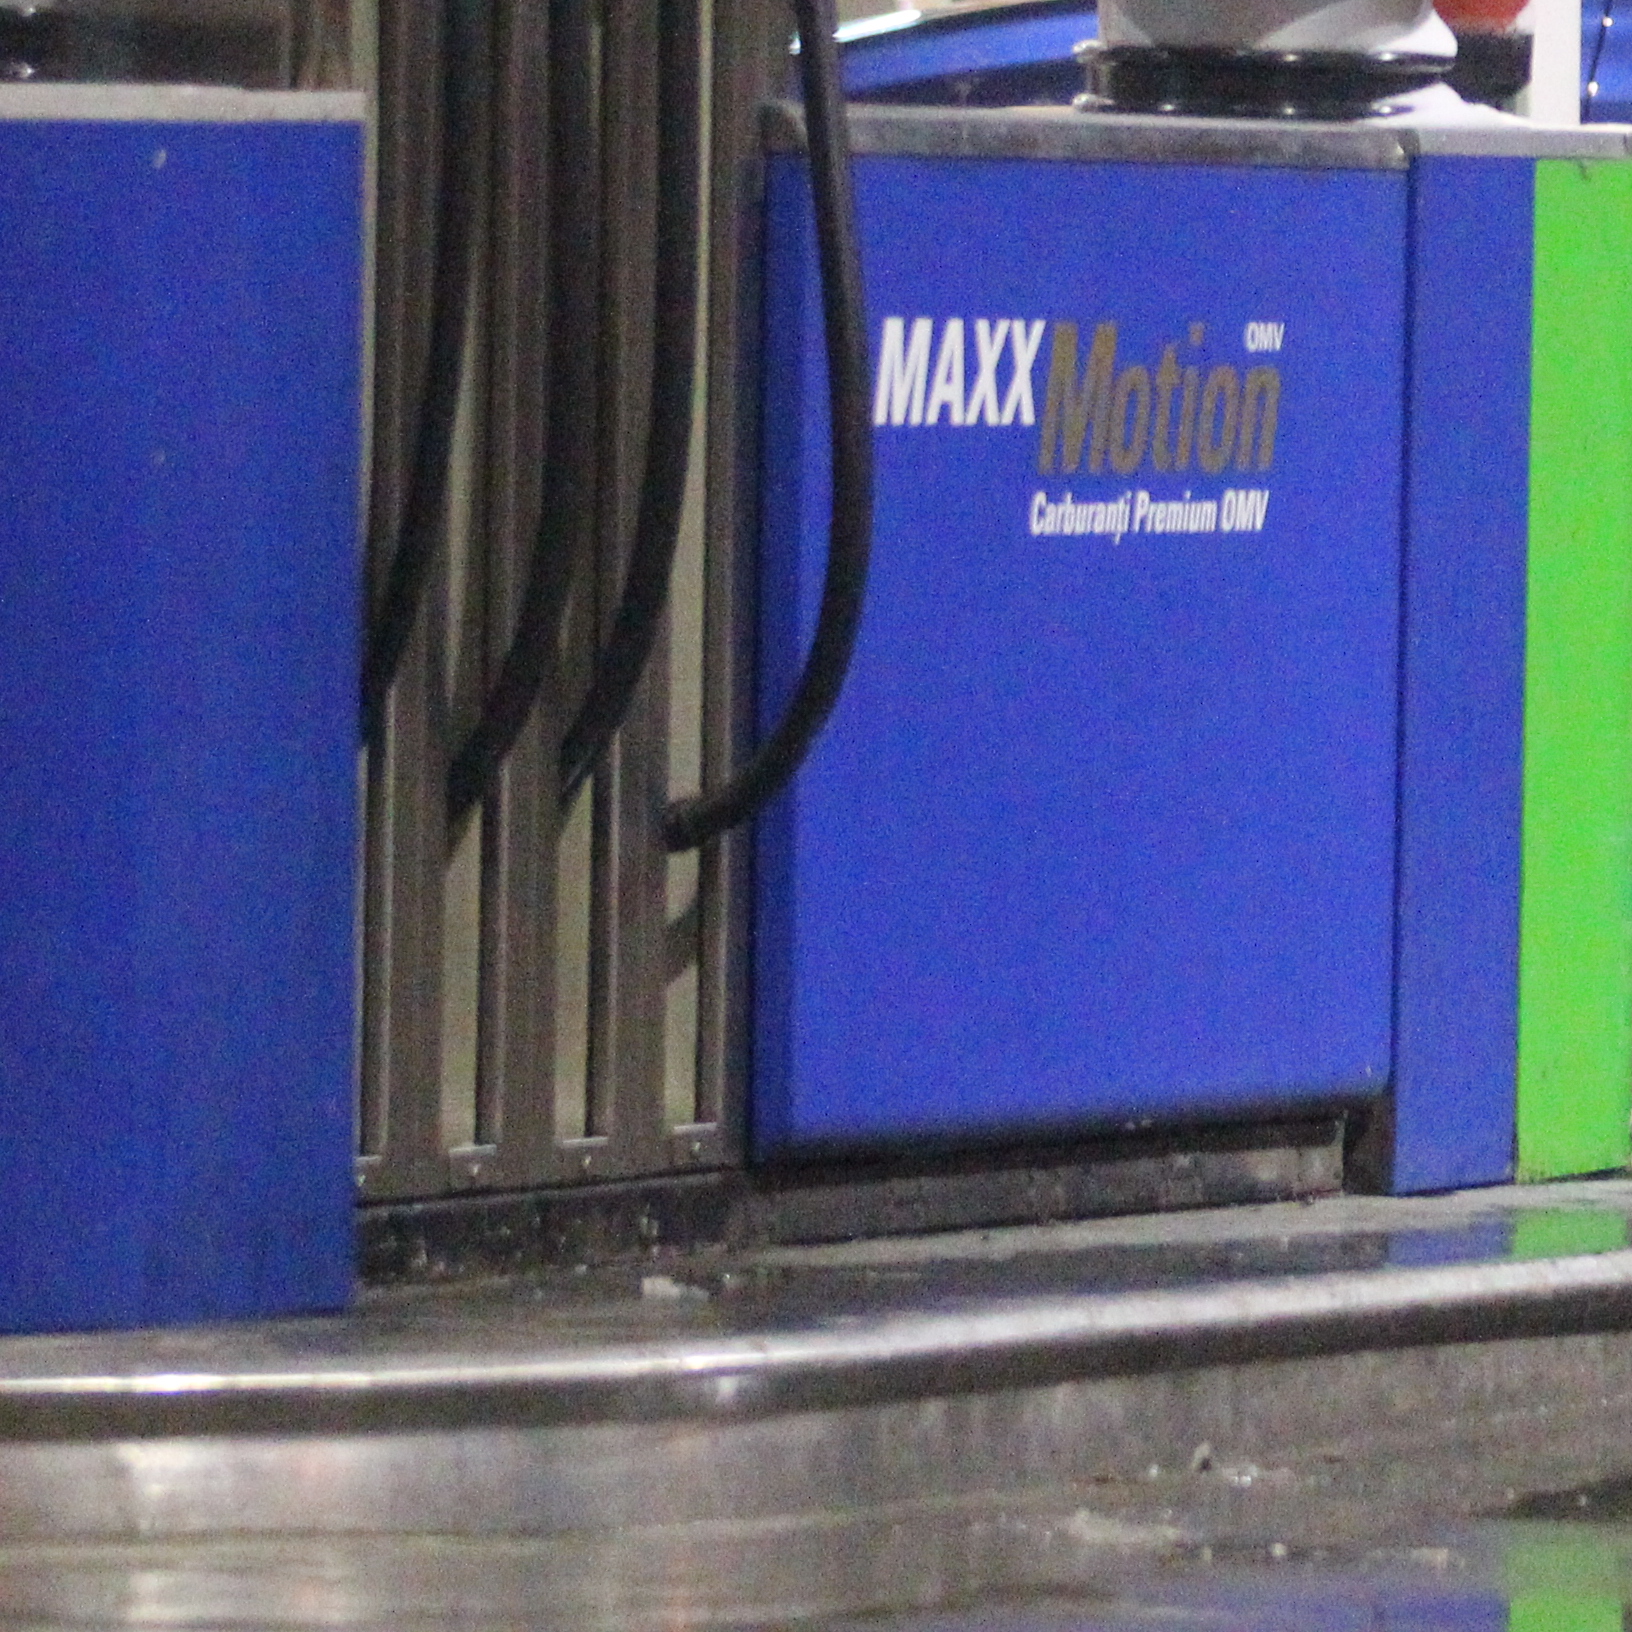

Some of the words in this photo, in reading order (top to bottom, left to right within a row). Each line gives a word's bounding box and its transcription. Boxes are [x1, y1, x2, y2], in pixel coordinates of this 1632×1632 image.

[1244, 322, 1285, 354] OMV
[873, 316, 1046, 427] MAXX
[1037, 320, 1284, 476] Motion
[1134, 490, 1217, 534] Premium
[1220, 489, 1270, 532] OMV
